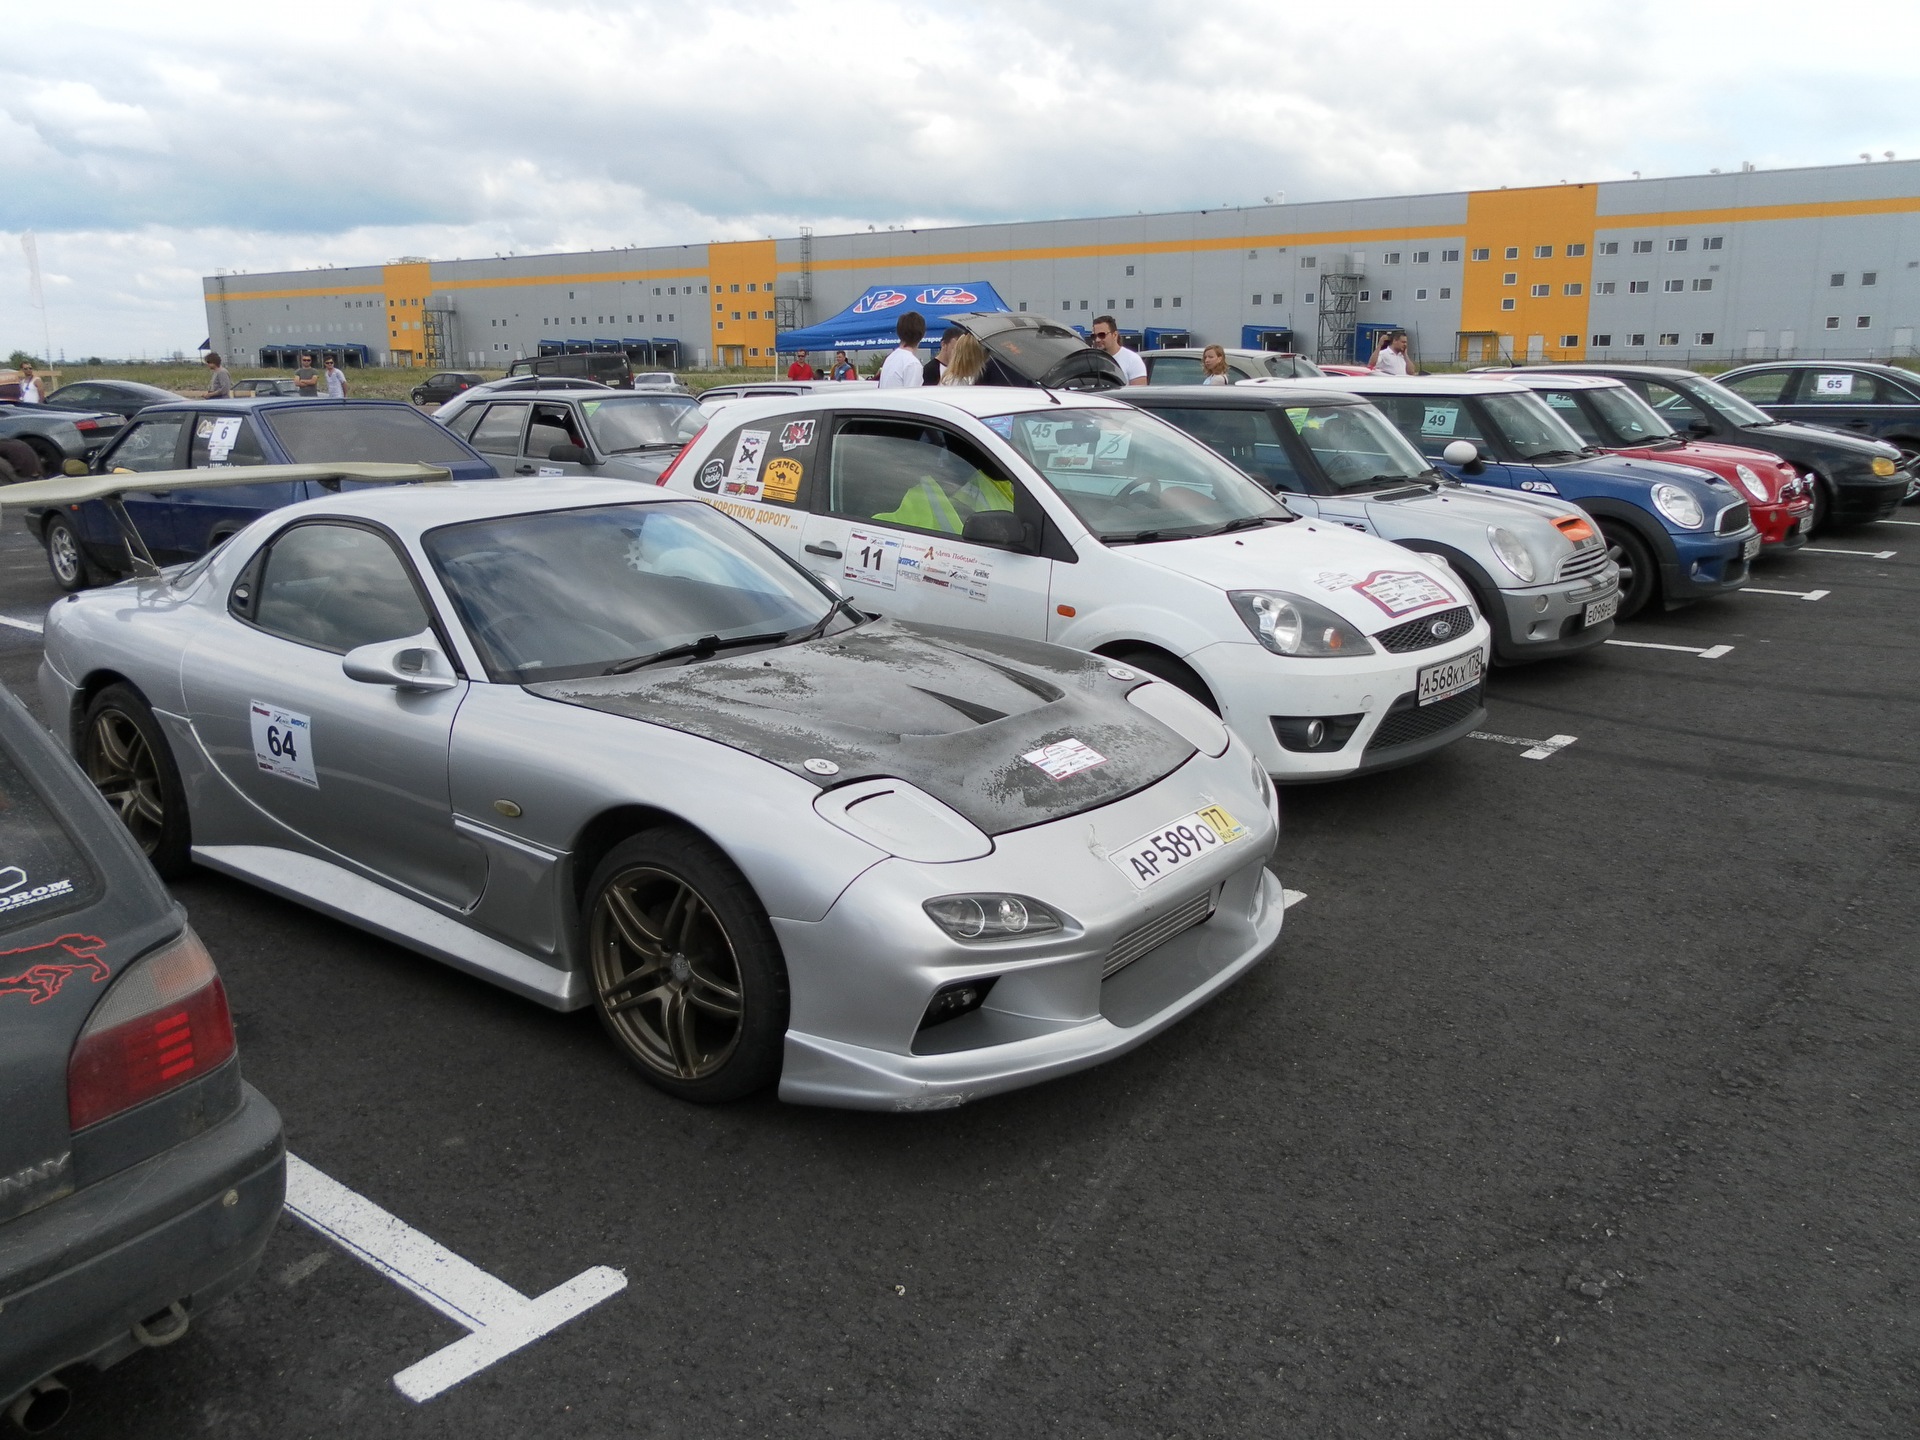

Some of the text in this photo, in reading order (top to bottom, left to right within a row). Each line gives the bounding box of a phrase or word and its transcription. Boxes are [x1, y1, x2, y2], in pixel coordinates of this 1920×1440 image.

[860, 290, 895, 312] VP
[924, 287, 964, 304] VP
[834, 339, 865, 347] Advancing
[1827, 380, 1842, 389] 65
[1428, 414, 1446, 426] 49
[221, 426, 229, 440] 6
[1031, 423, 1052, 438] 45
[768, 460, 800, 475] CAMEL
[755, 509, 791, 529] ДОРОГУ
[861, 545, 883, 571] 11
[1423, 665, 1466, 695] A568KX
[267, 725, 297, 762] 64
[1201, 808, 1229, 831] 77
[1219, 828, 1235, 839] RUS
